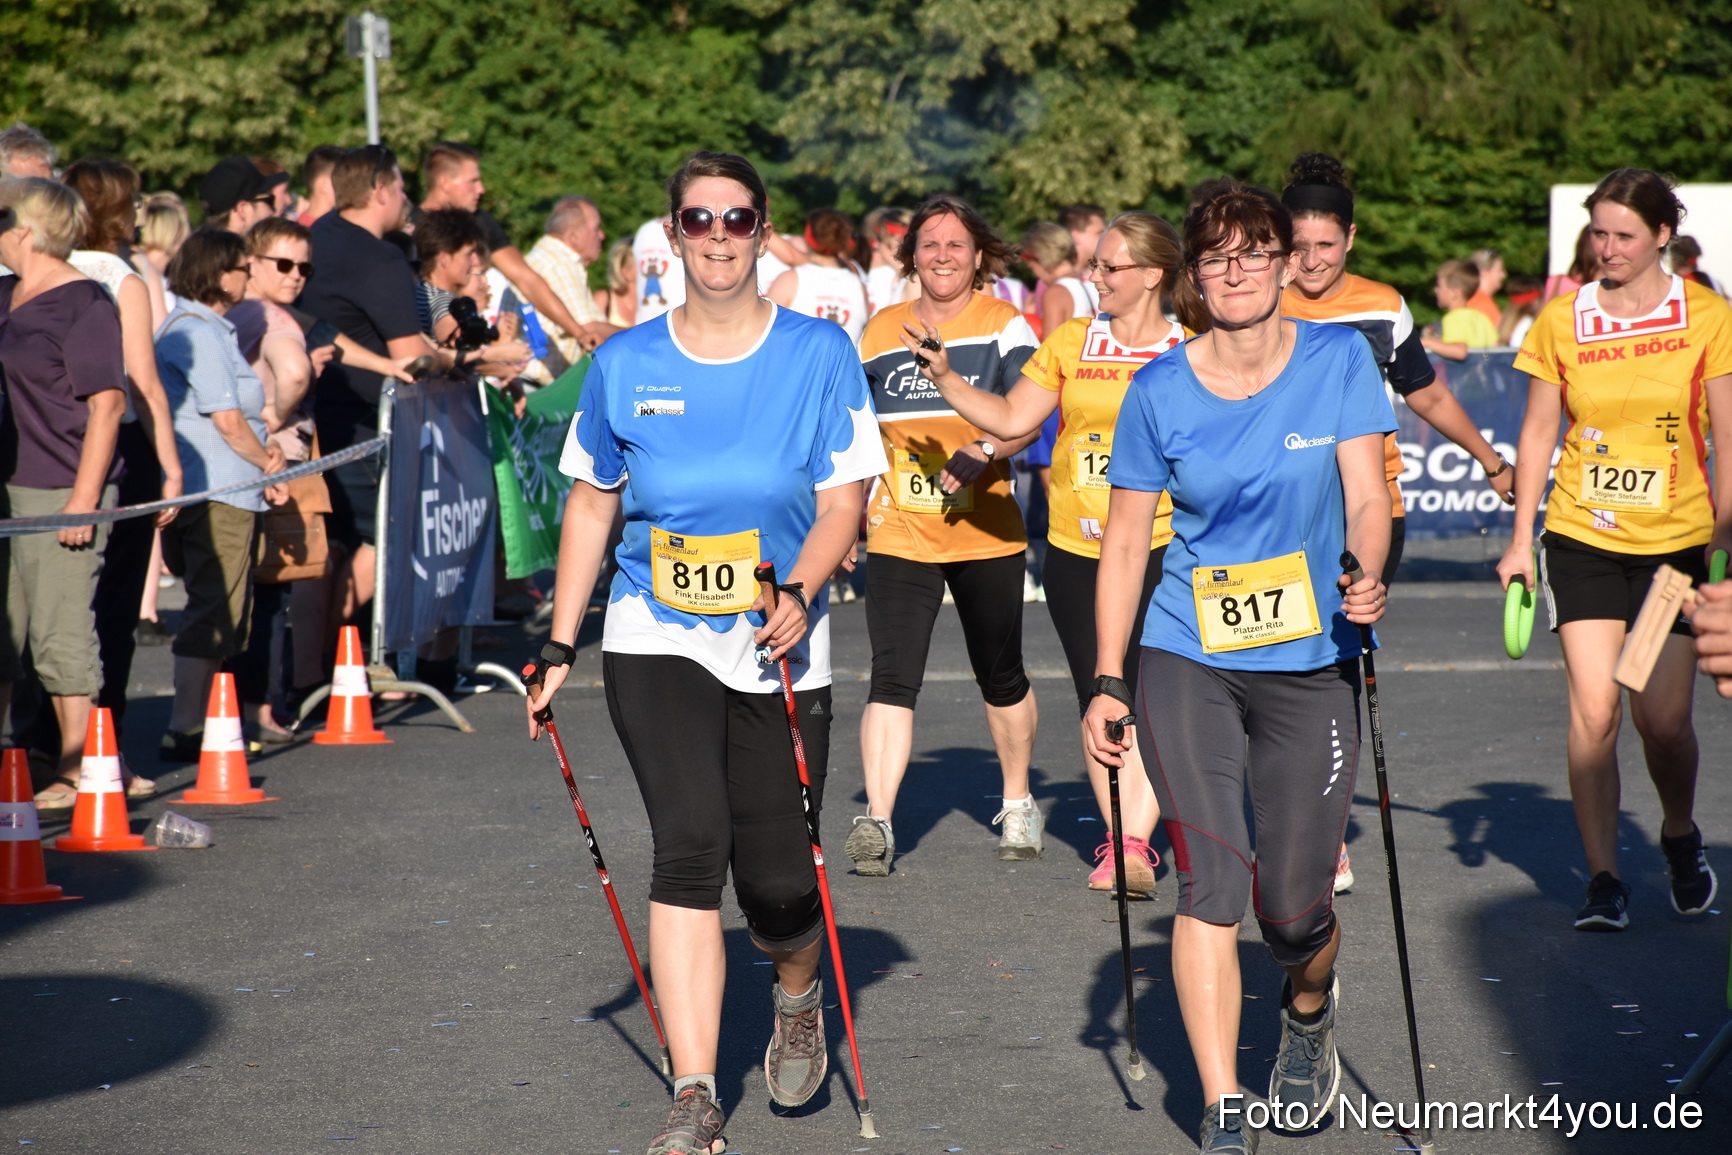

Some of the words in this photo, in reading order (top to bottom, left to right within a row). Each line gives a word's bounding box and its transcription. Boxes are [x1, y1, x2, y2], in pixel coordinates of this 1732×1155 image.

[1577, 346, 1626, 365] MAX
[1634, 338, 1690, 358] BÖGL
[1075, 368, 1119, 381] MAX
[1589, 465, 1657, 493] 1207
[421, 482, 487, 558] Fischer
[663, 542, 699, 555] firmenlauf
[672, 562, 735, 592] 810
[1207, 578, 1244, 589] firmenlauf
[675, 590, 692, 599] Fink
[694, 592, 735, 600] Elisabeth
[1220, 588, 1284, 626] 817
[1233, 625, 1264, 635] Platzer
[1266, 621, 1284, 630] Rita
[1255, 630, 1276, 638] classic
